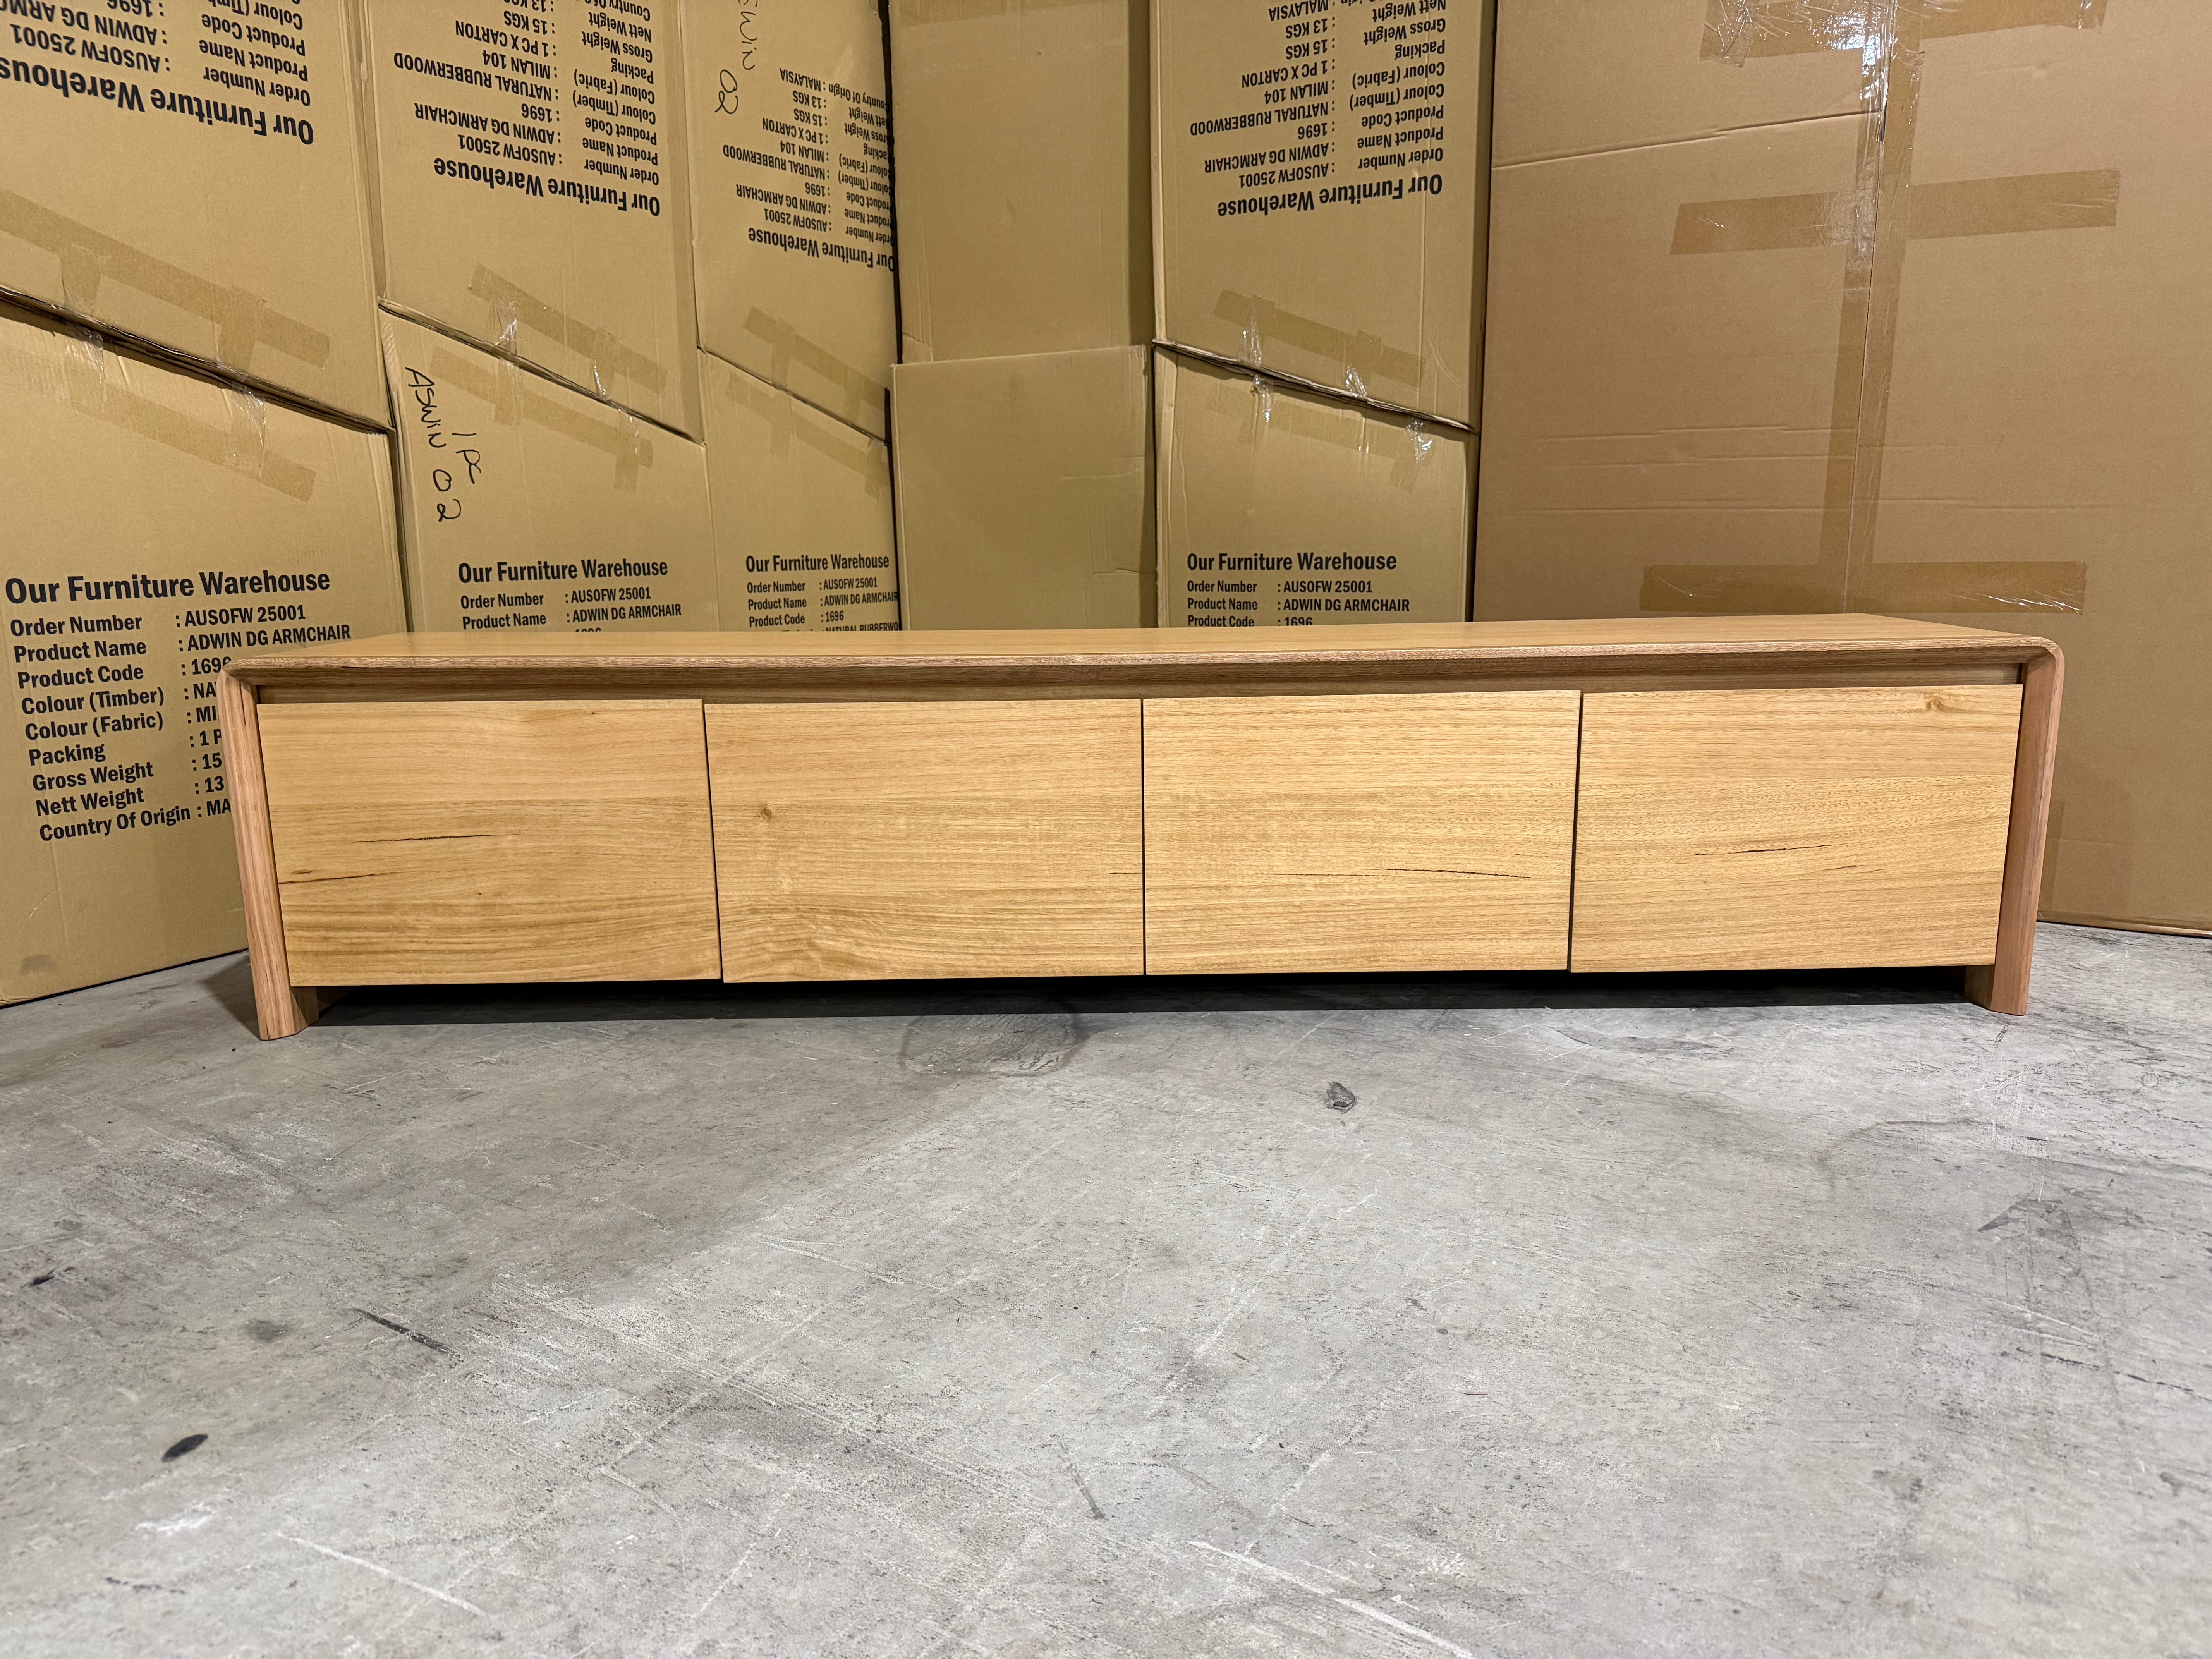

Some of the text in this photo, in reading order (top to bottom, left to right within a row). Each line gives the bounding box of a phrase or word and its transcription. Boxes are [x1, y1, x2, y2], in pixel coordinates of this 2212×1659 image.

[254, 2, 303, 30] Colour
[1363, 18, 1446, 46] Gross Weight
[60, 7, 308, 82] Product Name ADWIN DG
[201, 14, 306, 57] Product Code
[581, 31, 653, 64] Gross Weight
[10, 23, 311, 106] Order Number AUSOFW 25001
[455, 20, 654, 84] Packing CARTON
[1242, 40, 1445, 88] Packing CARTON
[394, 52, 656, 125] Colour (Timber) NATURAL RUBBERWOOD
[482, 50, 655, 105] Colour (Fabric) MILAN 104
[780, 68, 821, 92] MALAYSIA
[1264, 62, 1445, 105] Colour (Fabric) MILAN 104
[150, 89, 267, 136] Furniture
[521, 103, 657, 146] Product Code 1696
[1190, 83, 1444, 136] Colour (Timber) NATURAL RUBBERWOOD
[1298, 105, 1444, 140] Product Code 1696
[273, 114, 314, 145] Our
[414, 103, 658, 166] Product Name ADWIN DG ARMCHAIR
[457, 134, 659, 186] Order Number AUSOFW 25001
[723, 145, 825, 180] NATURAL RUBBERWOOD
[799, 145, 824, 163] MILAN
[1204, 126, 1443, 173] Product Name ADWIN DG ARMCHAIR
[1239, 148, 1443, 188] Order Number AUSOFW 25001
[434, 158, 660, 216] Our Furniture Warehouse
[736, 184, 827, 215] ADWIN ARMCHAIR
[1218, 174, 1442, 216] Our Furniture Warehouse
[764, 208, 827, 232] AUSOFW 25001
[748, 228, 874, 268] Furniture Warehouse
[459, 558, 668, 583] Our Furniture Warehouse
[746, 553, 889, 572] Our Furniture Warehouse
[1187, 552, 1397, 570] Our Furniture Warehouse
[5, 570, 330, 604] Our Furniture Warehouse
[460, 587, 651, 609] Order Number AUSOFW 25001
[747, 577, 878, 593] Order Number AUSOFW 25001
[1187, 580, 1372, 593] Order Number AUSOFW 25001
[462, 603, 682, 630] Product Name ADWIN DG ARMCHAIR
[748, 598, 782, 611] Product
[783, 598, 807, 608] Name
[824, 594, 848, 606] ADWIN
[850, 594, 860, 605] DG
[749, 610, 844, 627] Product Code 1696
[1188, 598, 1410, 611] Product Name ADWIN DG ARMCHAIR
[10, 605, 306, 637] Order Number AUSOFW 25001
[1188, 615, 1226, 627] Product
[1229, 615, 1254, 627] Code
[14, 624, 351, 663] Product Name ADWIN DG ARMCHAIR
[17, 664, 144, 689] Product Code
[22, 687, 164, 714] Colour (Timber)
[25, 711, 163, 740] Colour (Fabric)
[29, 744, 106, 766] Packing
[33, 761, 154, 791] Gross Weight
[36, 787, 145, 816] Nett Weight
[40, 818, 112, 841] Country
[116, 811, 136, 830] Of
[141, 805, 191, 826] Origin
